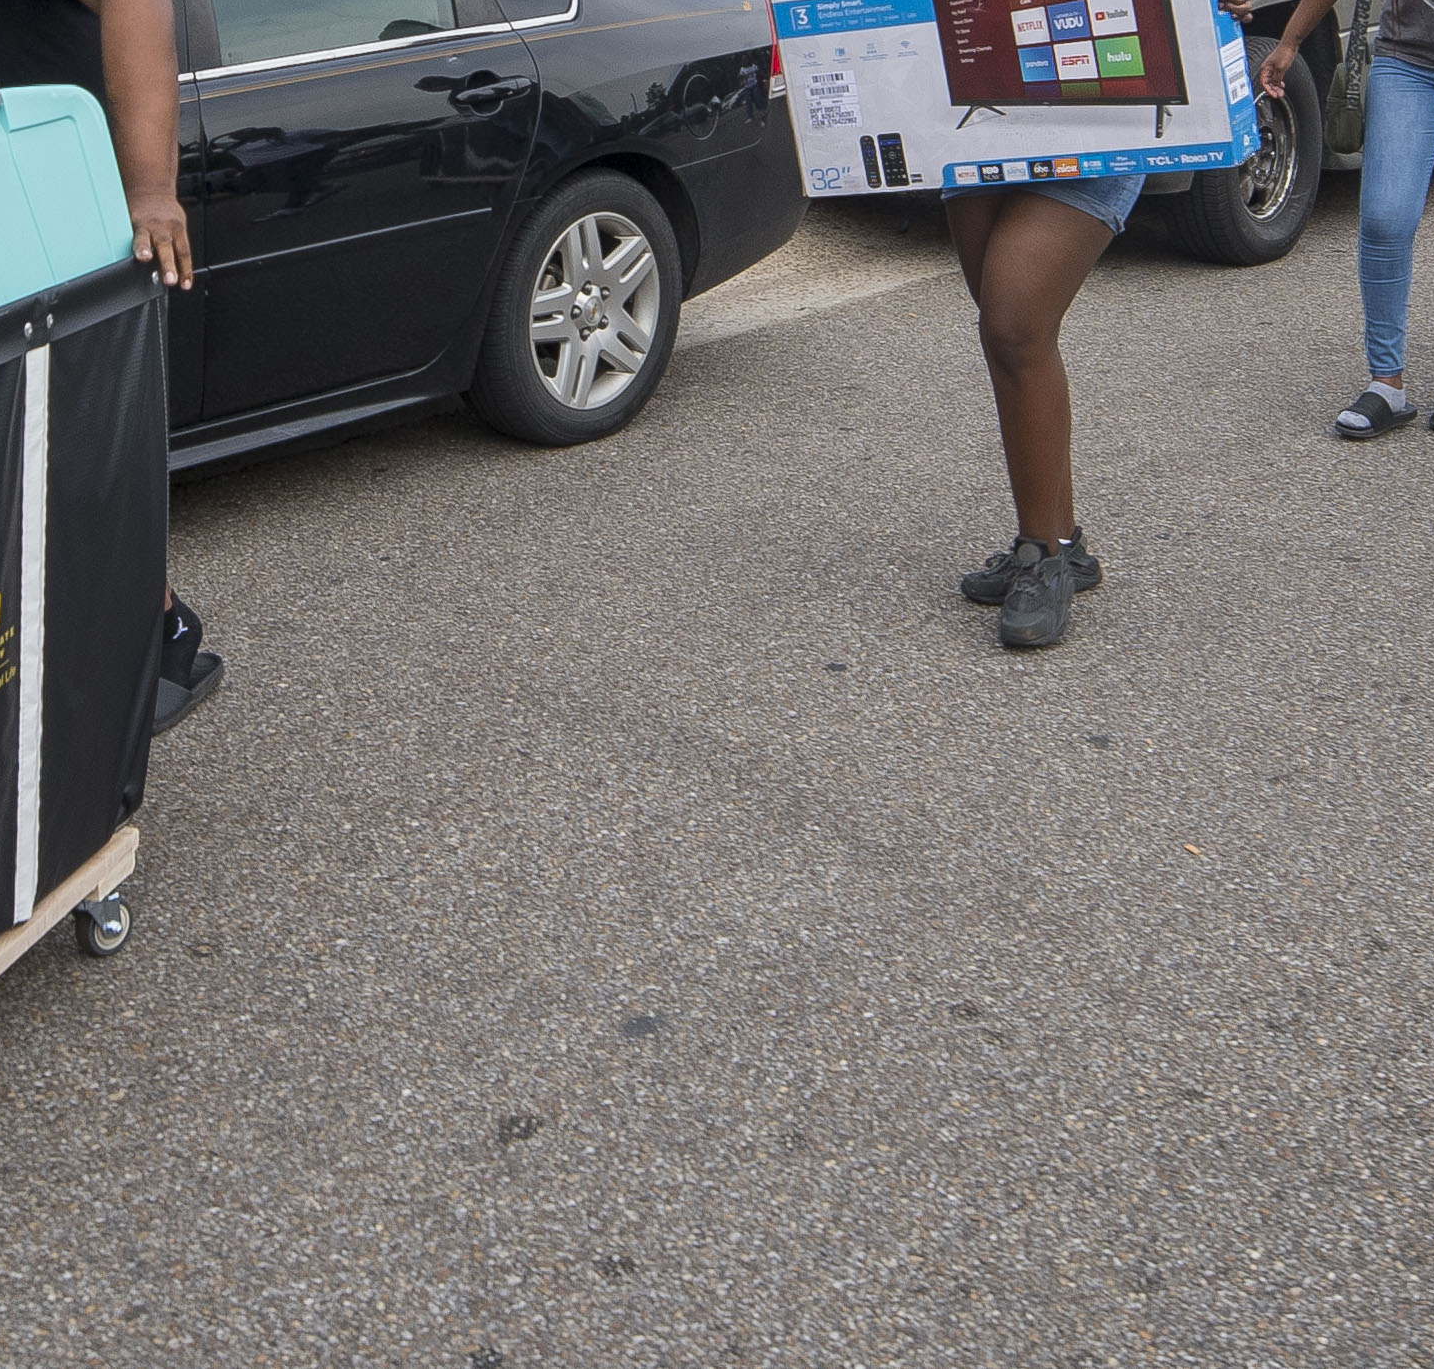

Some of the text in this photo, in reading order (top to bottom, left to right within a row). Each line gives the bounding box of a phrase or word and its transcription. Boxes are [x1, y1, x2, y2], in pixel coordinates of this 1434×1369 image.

[817, 1, 840, 11] Simply
[1017, 20, 1045, 33] NETFLIX
[1053, 16, 1084, 30] VUDU
[1061, 54, 1090, 67] ESPN
[1106, 51, 1132, 63] hulu
[1147, 156, 1174, 166] TCL
[1209, 151, 1224, 162] TV
